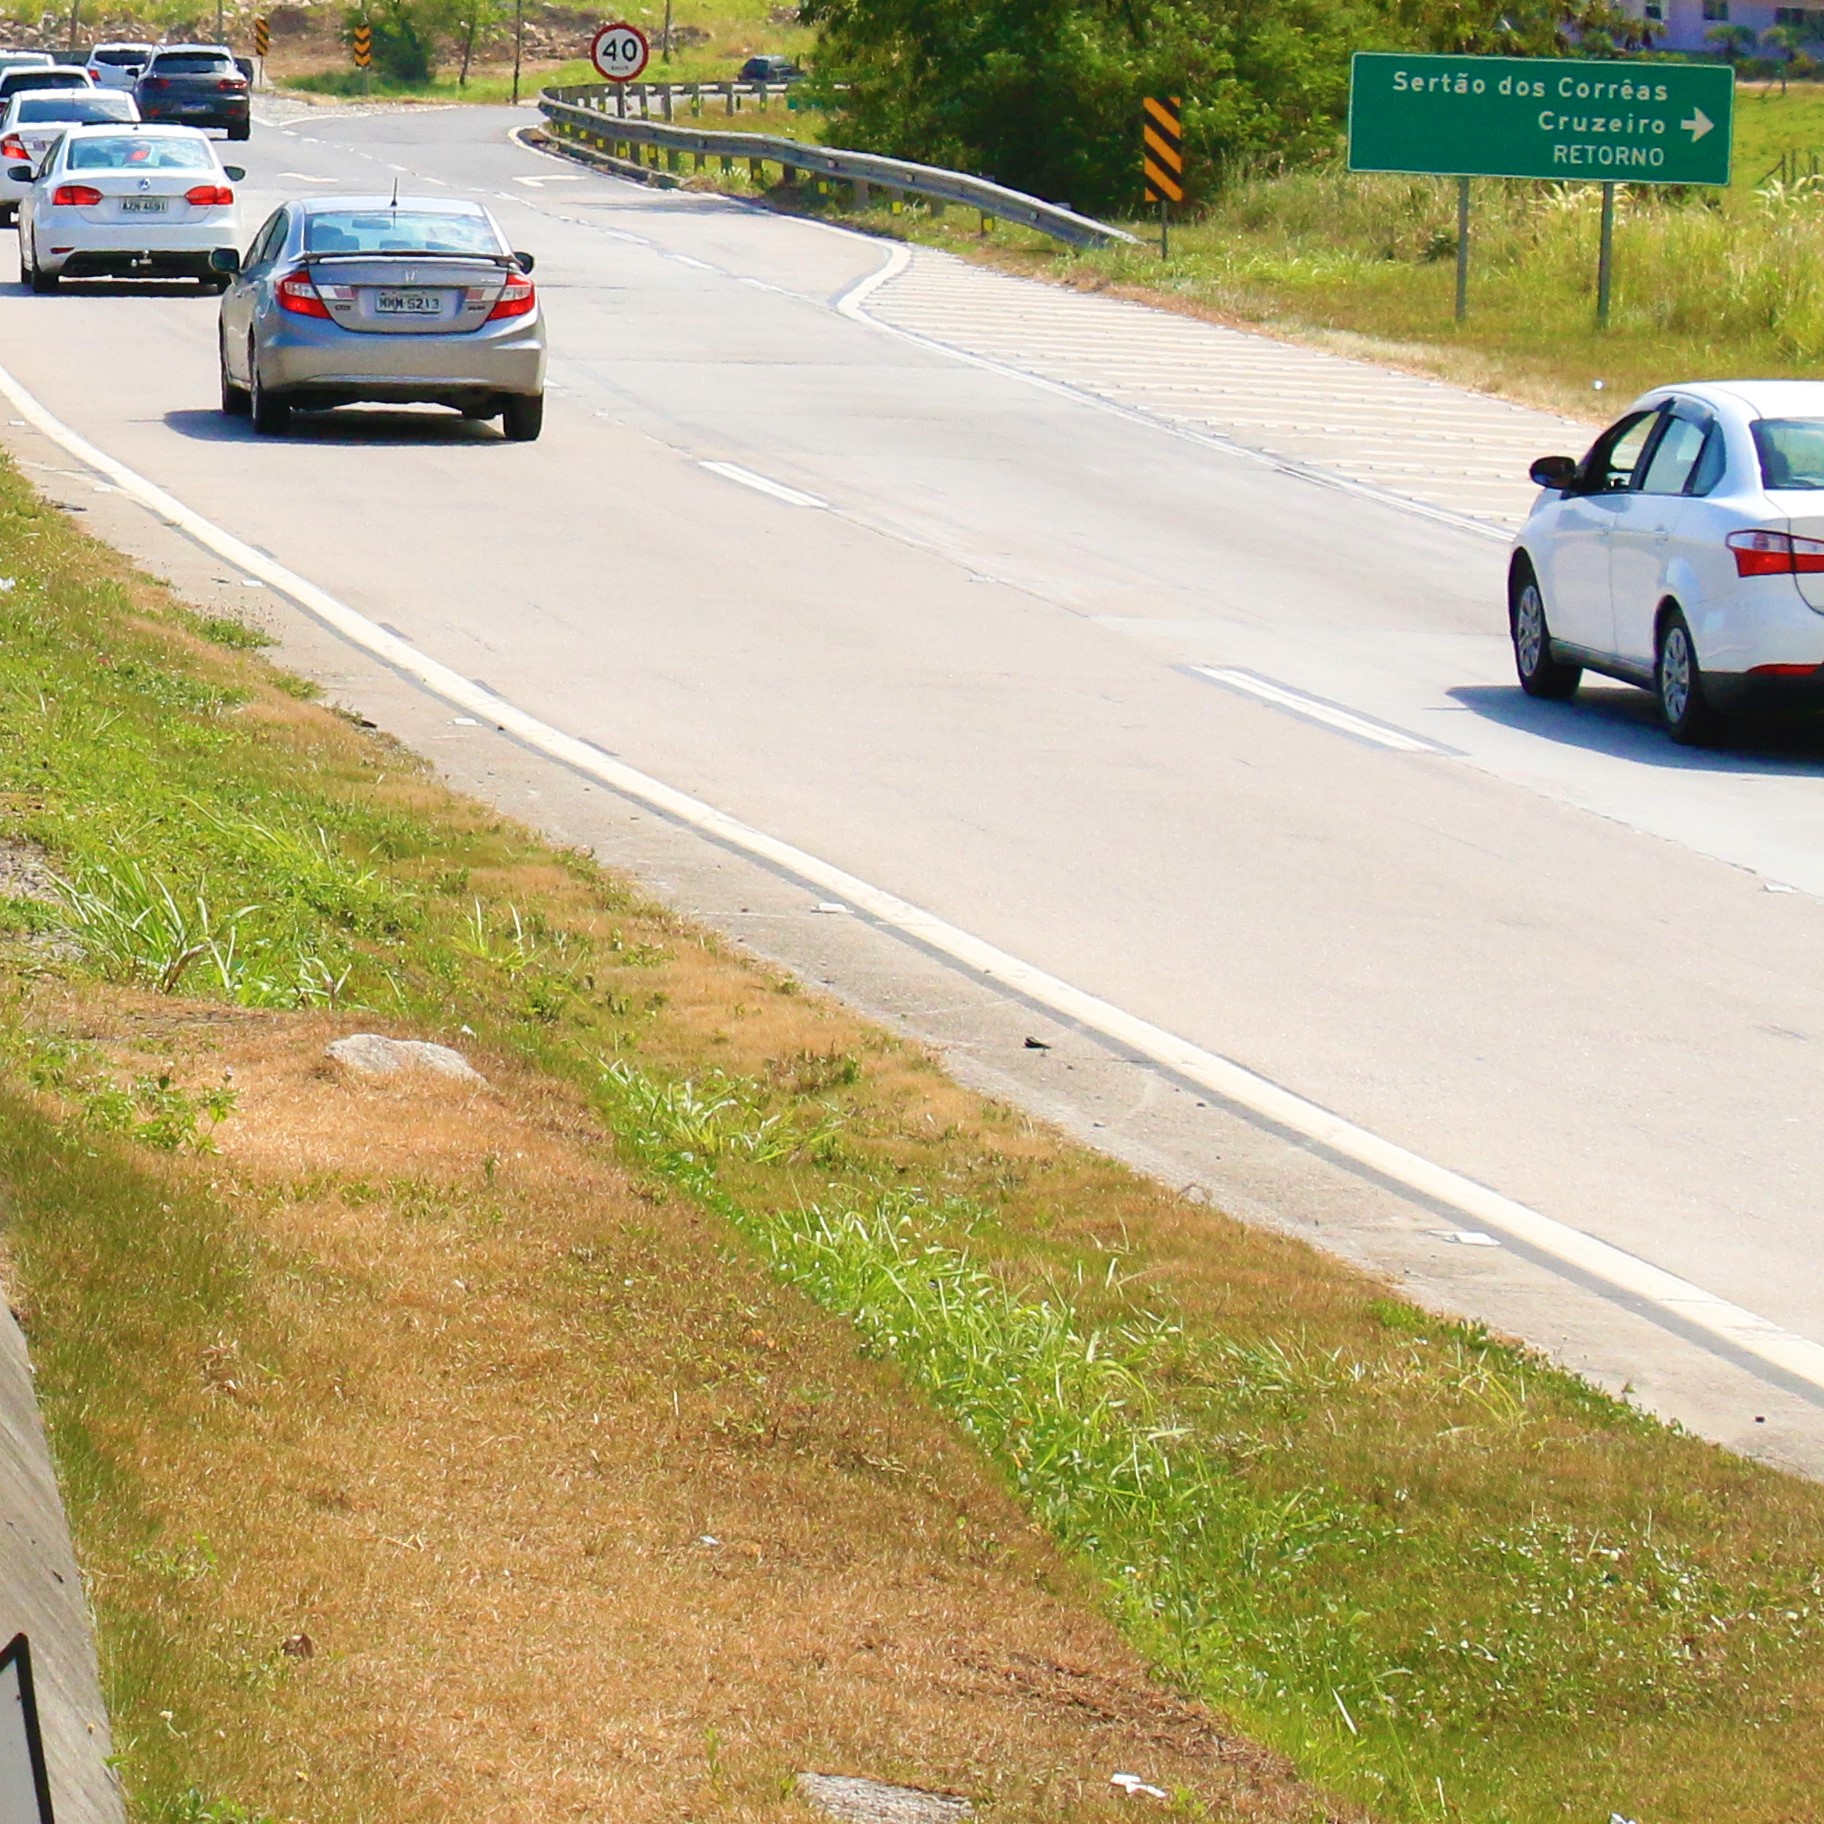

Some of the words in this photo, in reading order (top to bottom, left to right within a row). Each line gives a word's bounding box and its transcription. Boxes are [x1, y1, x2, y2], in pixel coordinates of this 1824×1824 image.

[603, 38, 637, 61] 40
[1392, 71, 1487, 95] Sertão
[1498, 75, 1546, 97] dos
[1558, 77, 1669, 101] Corrêas
[1538, 111, 1666, 134] Cruzeiro
[1553, 144, 1665, 166] RETORNO
